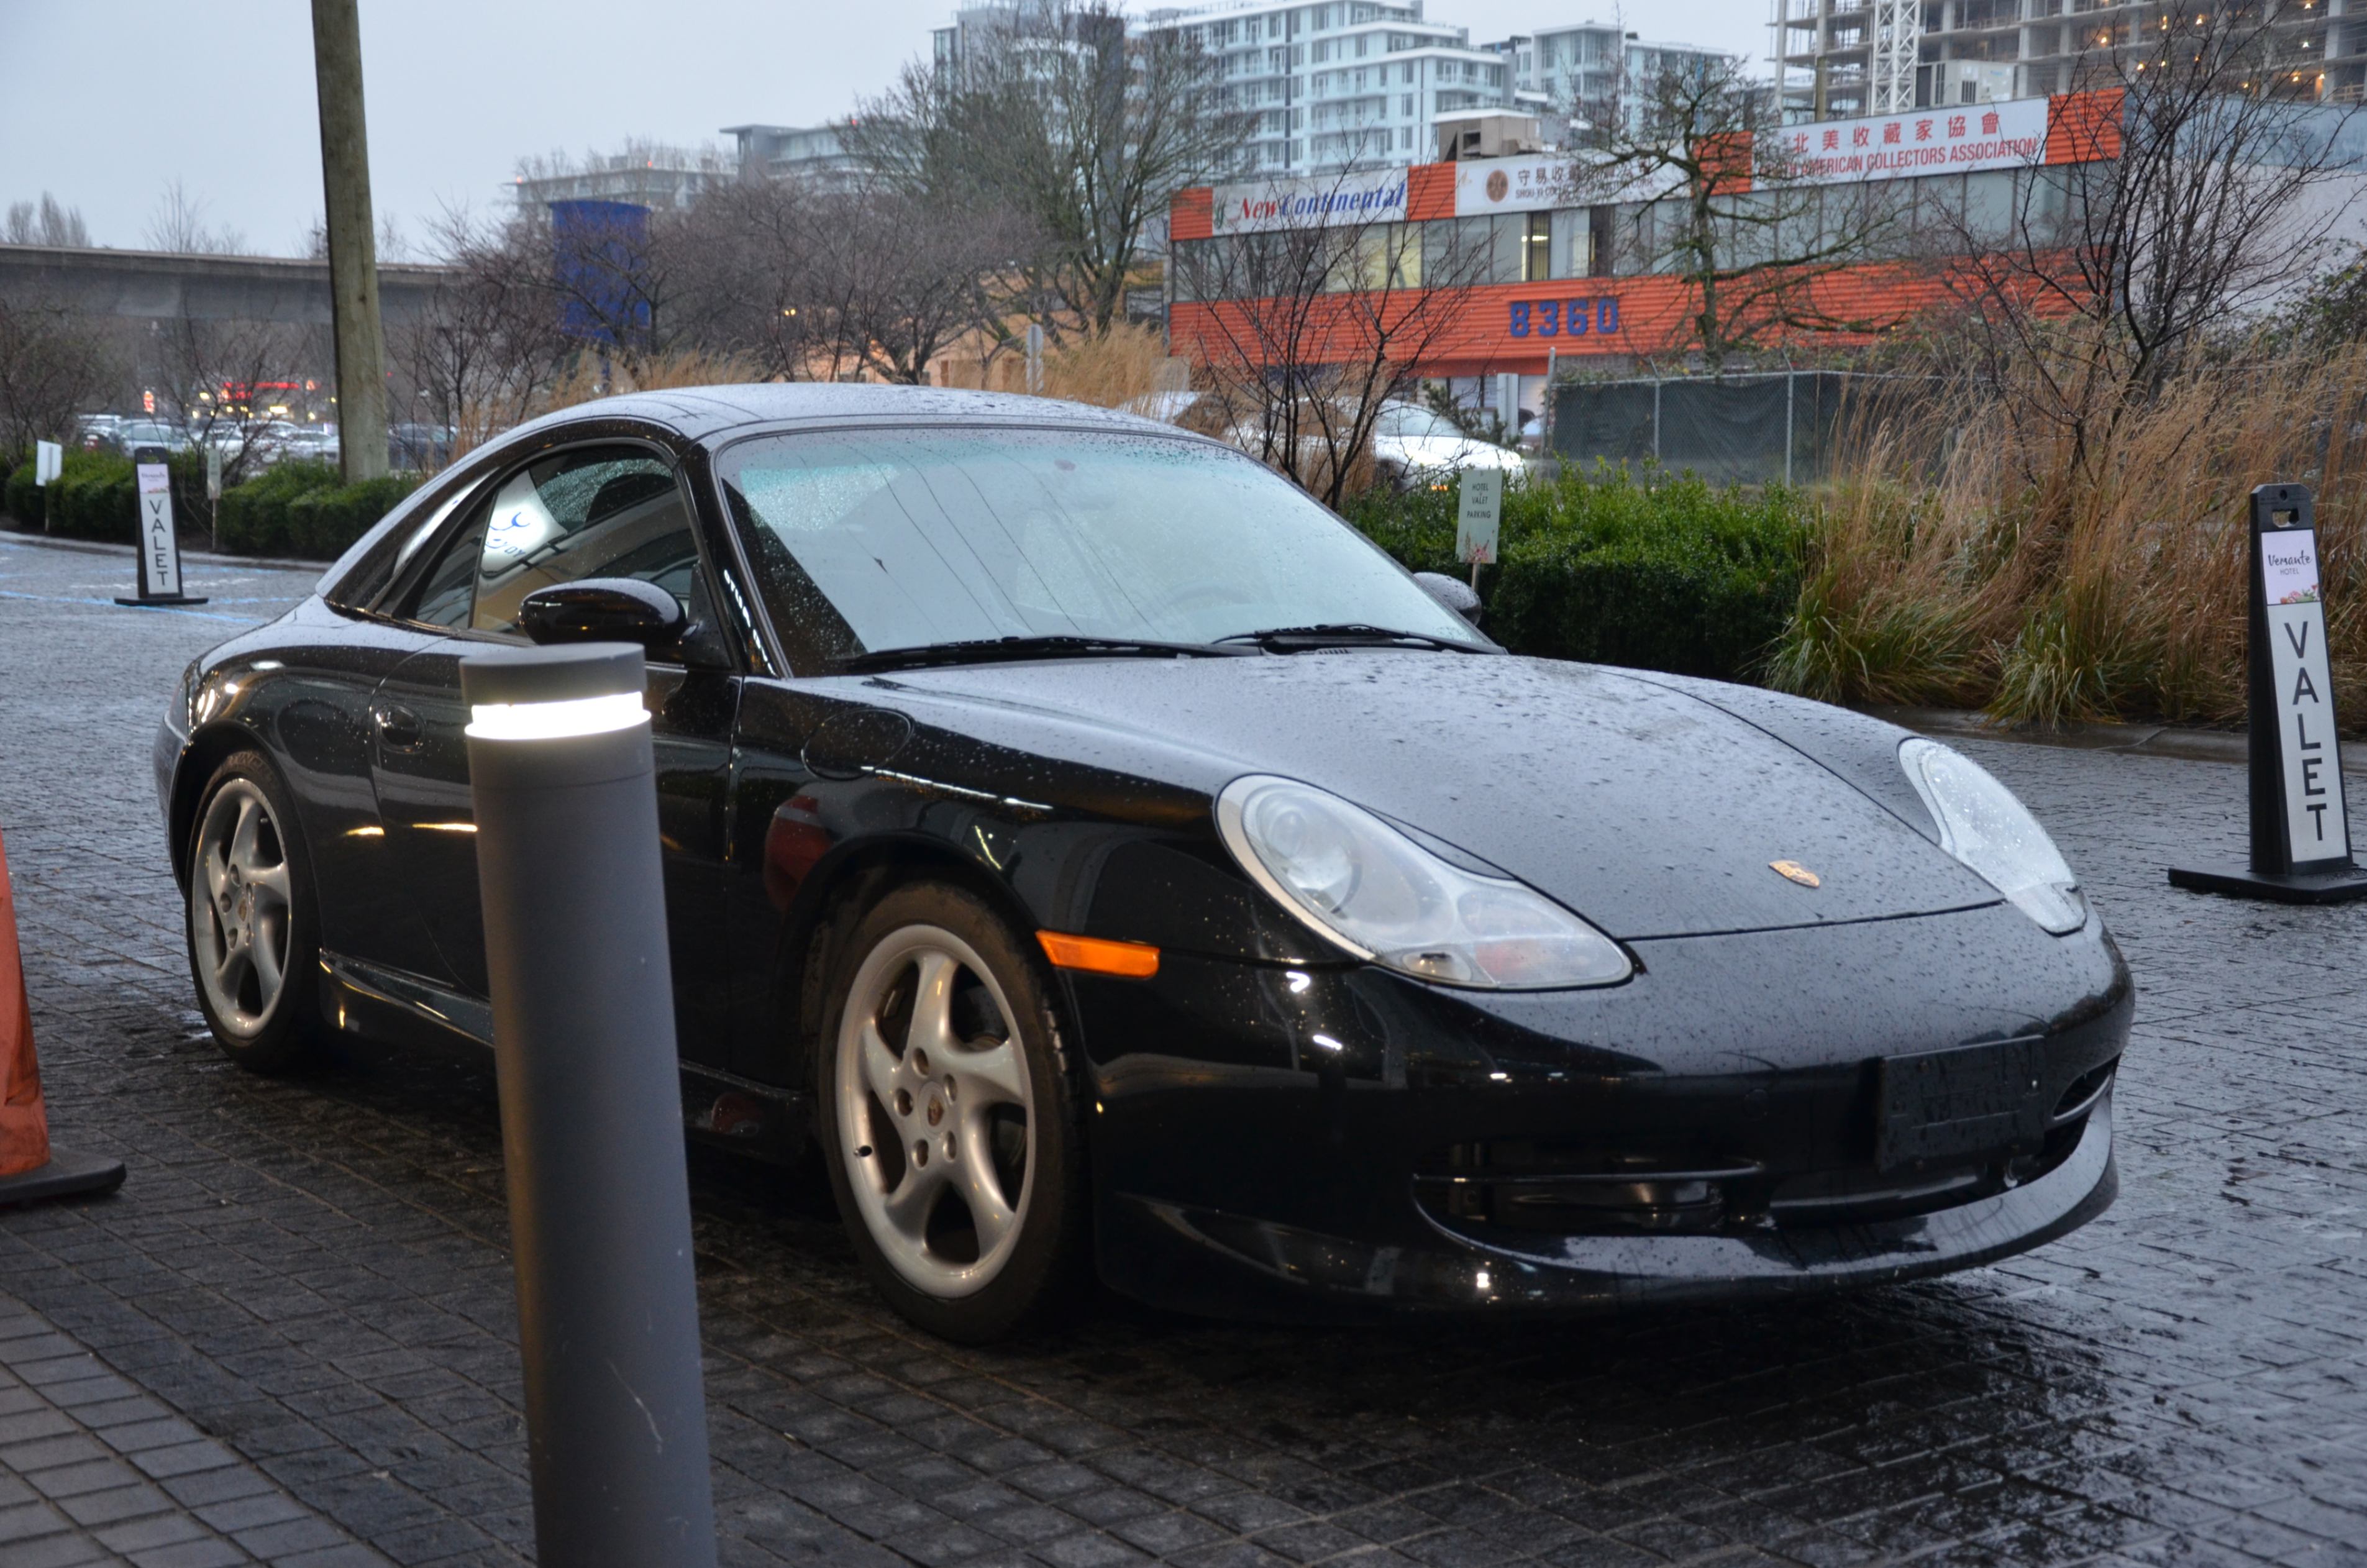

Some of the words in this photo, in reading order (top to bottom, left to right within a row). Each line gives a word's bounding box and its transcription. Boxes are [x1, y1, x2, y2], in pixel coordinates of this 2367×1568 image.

[1793, 112, 1999, 153] 北美收藏家協會
[1867, 146, 1946, 171] COLLECTORS
[1950, 137, 2037, 163] ASSOCIATION
[1243, 198, 1277, 219] New
[1282, 181, 1406, 217] Continental
[1516, 188, 1535, 199] SHOU
[1510, 296, 1618, 338] 8360
[1472, 483, 1489, 491] HOTEL
[1472, 496, 1488, 504] VALET
[1466, 510, 1491, 519] PARKING
[149, 499, 168, 586] VALET
[2268, 550, 2312, 567] Versante
[2284, 620, 2327, 842] VALET
